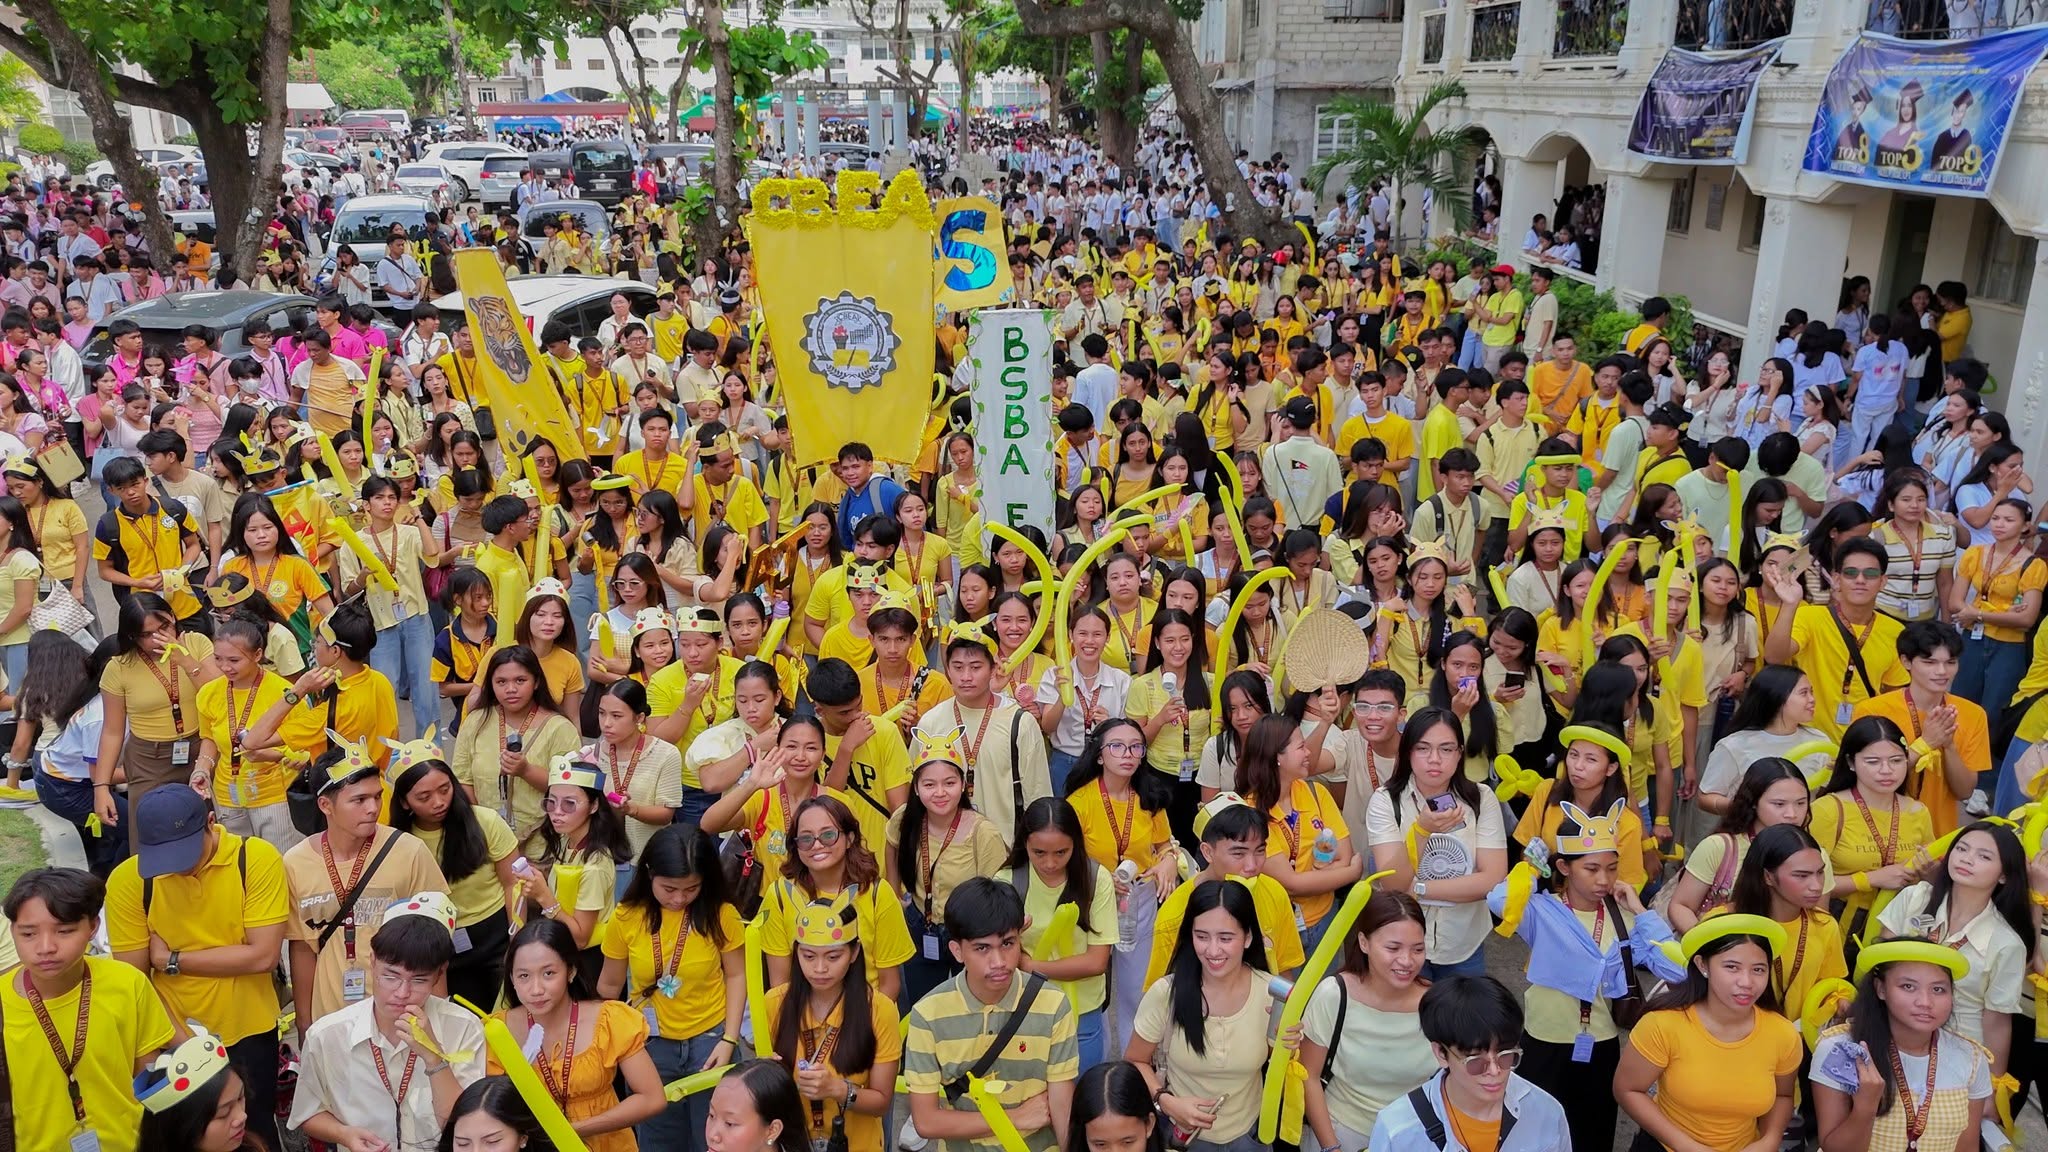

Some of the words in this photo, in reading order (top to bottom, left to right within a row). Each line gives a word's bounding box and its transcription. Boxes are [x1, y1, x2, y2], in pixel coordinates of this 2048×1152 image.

[1838, 146, 1860, 161] TOP
[1858, 133, 1870, 165] 8
[1881, 151, 1902, 166] TOP
[1902, 130, 1927, 171] 5
[1940, 155, 1965, 170] TOP
[1963, 143, 1983, 176] 9
[751, 168, 936, 231] CBEA
[1000, 326, 1030, 475] BSBA
